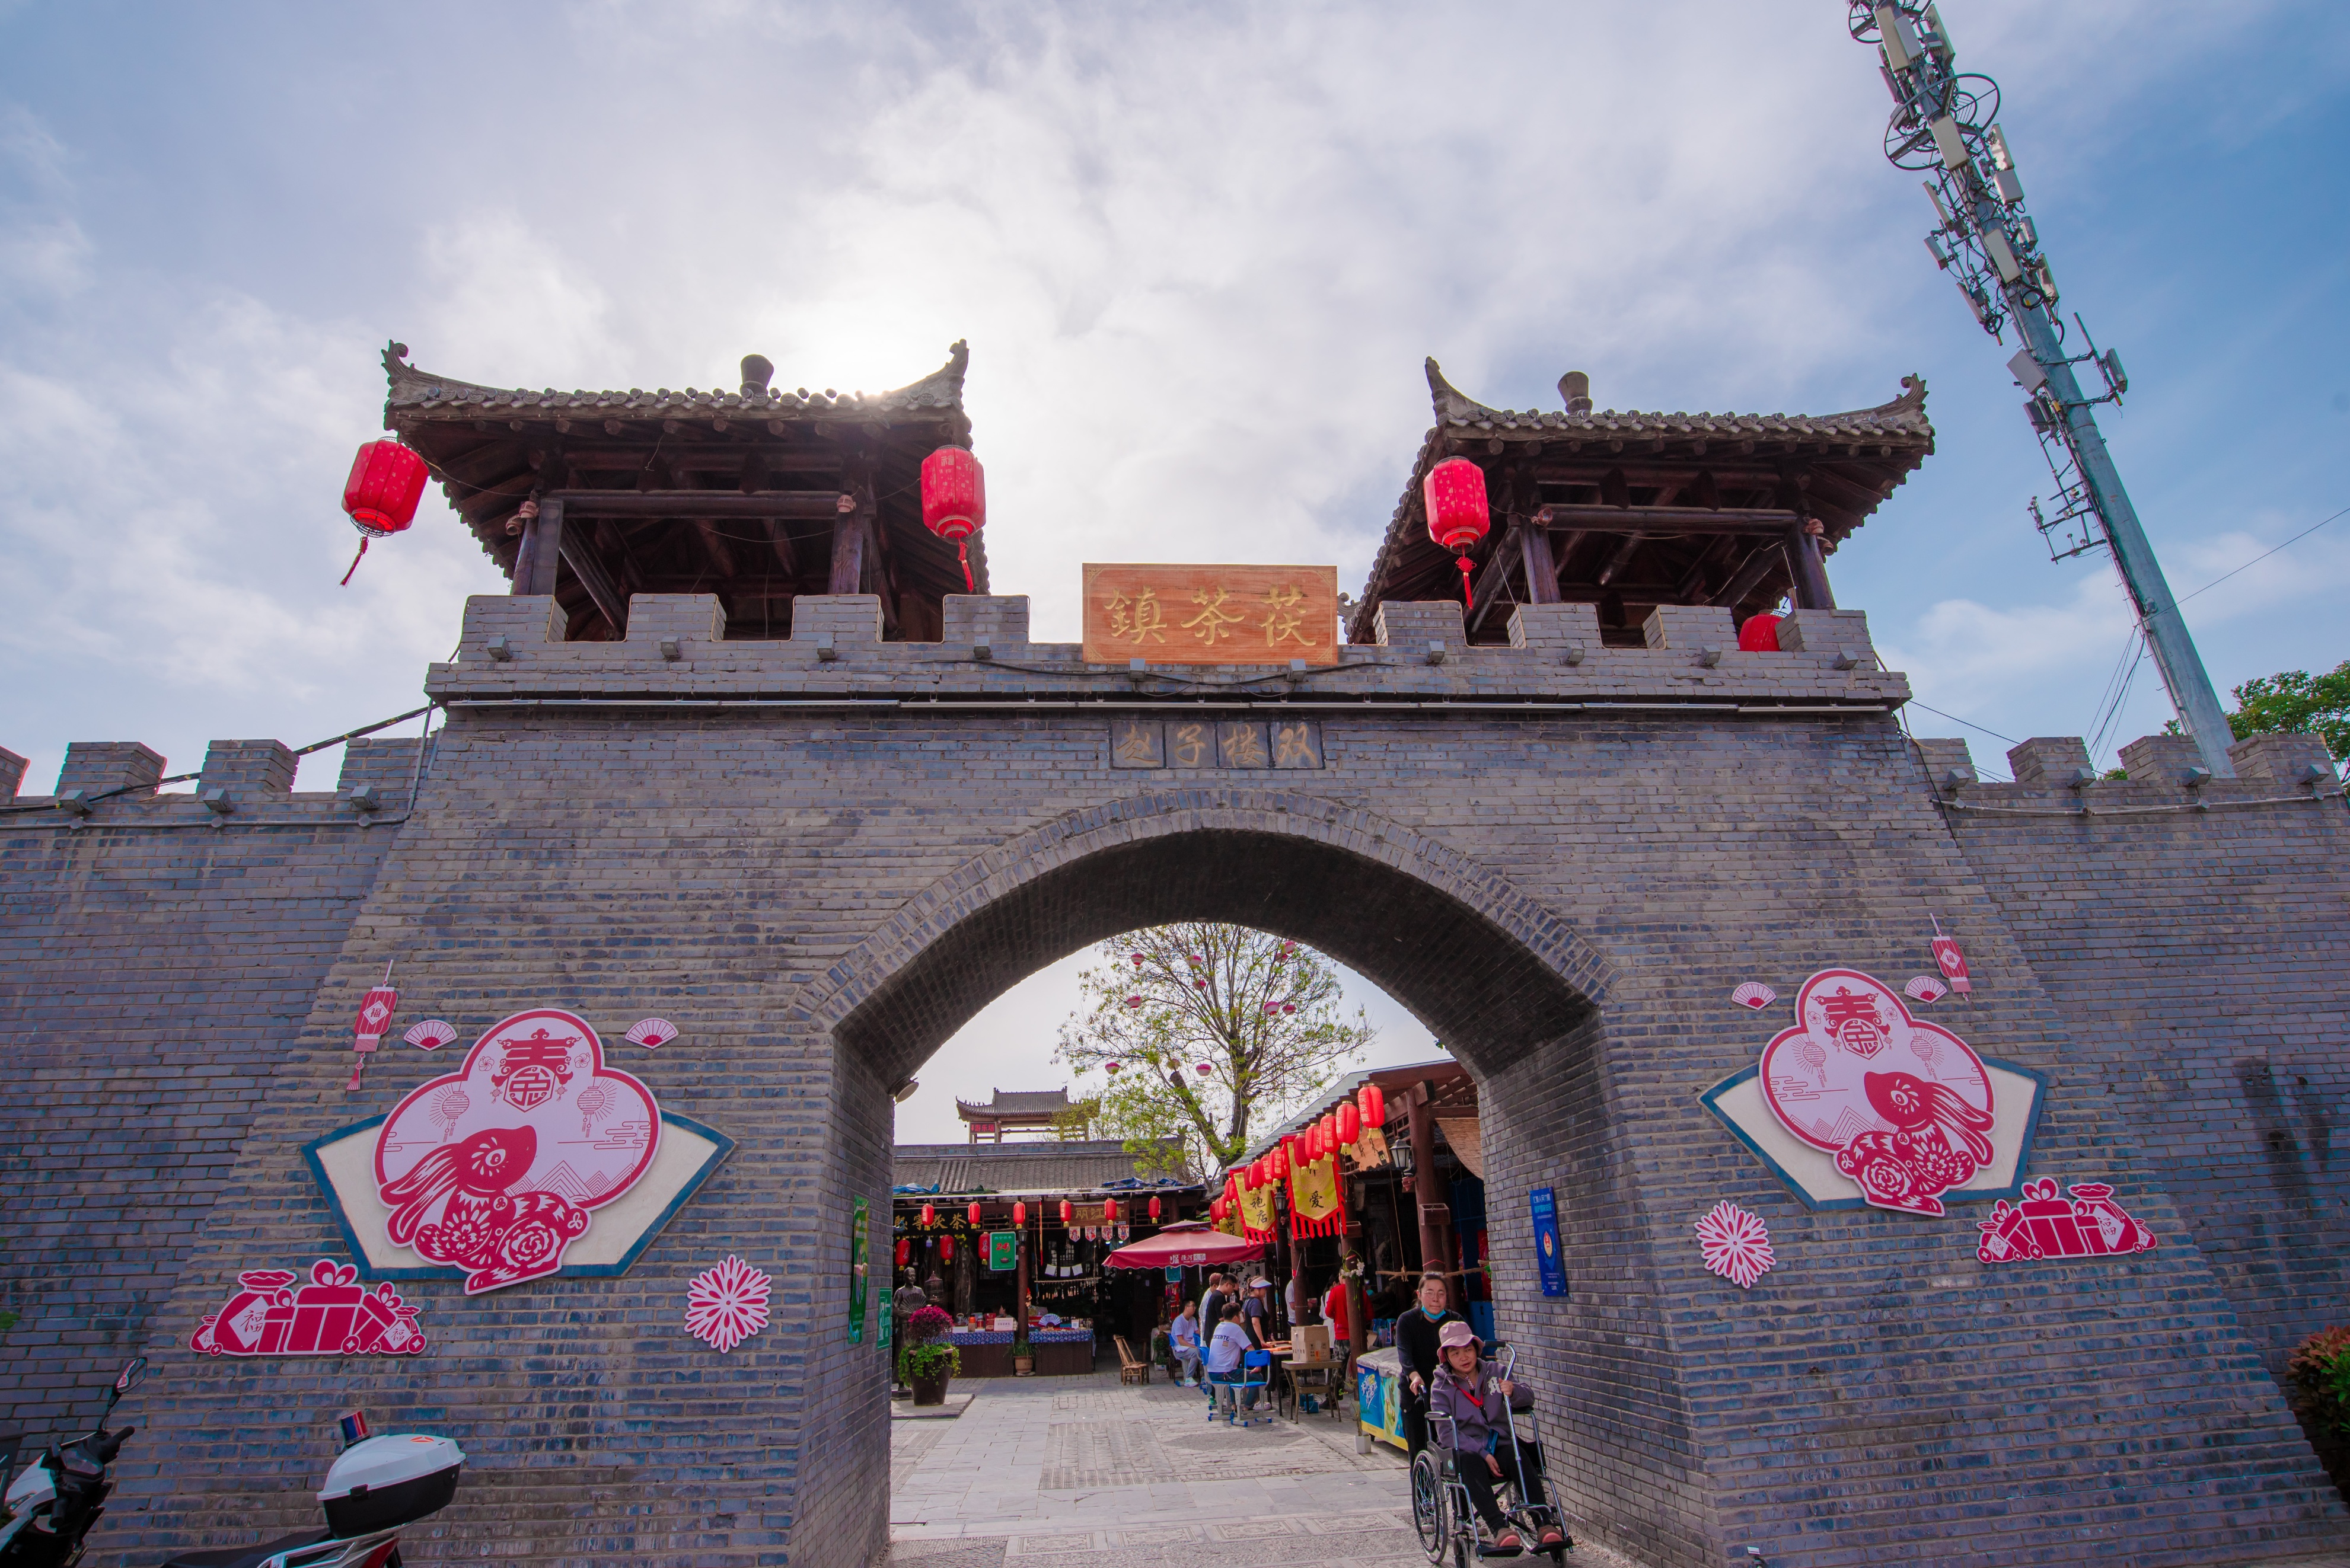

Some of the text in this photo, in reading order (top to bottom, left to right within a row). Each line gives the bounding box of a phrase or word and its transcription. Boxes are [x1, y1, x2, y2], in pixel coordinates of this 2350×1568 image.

[1945, 954, 1956, 963] 福
[370, 1008, 382, 1018] 福
[971, 1124, 994, 1132] 游乐场
[2098, 1217, 2116, 1236] 福
[1992, 1240, 2004, 1252] 福
[240, 1309, 263, 1333] 福
[390, 1328, 405, 1342] 福
